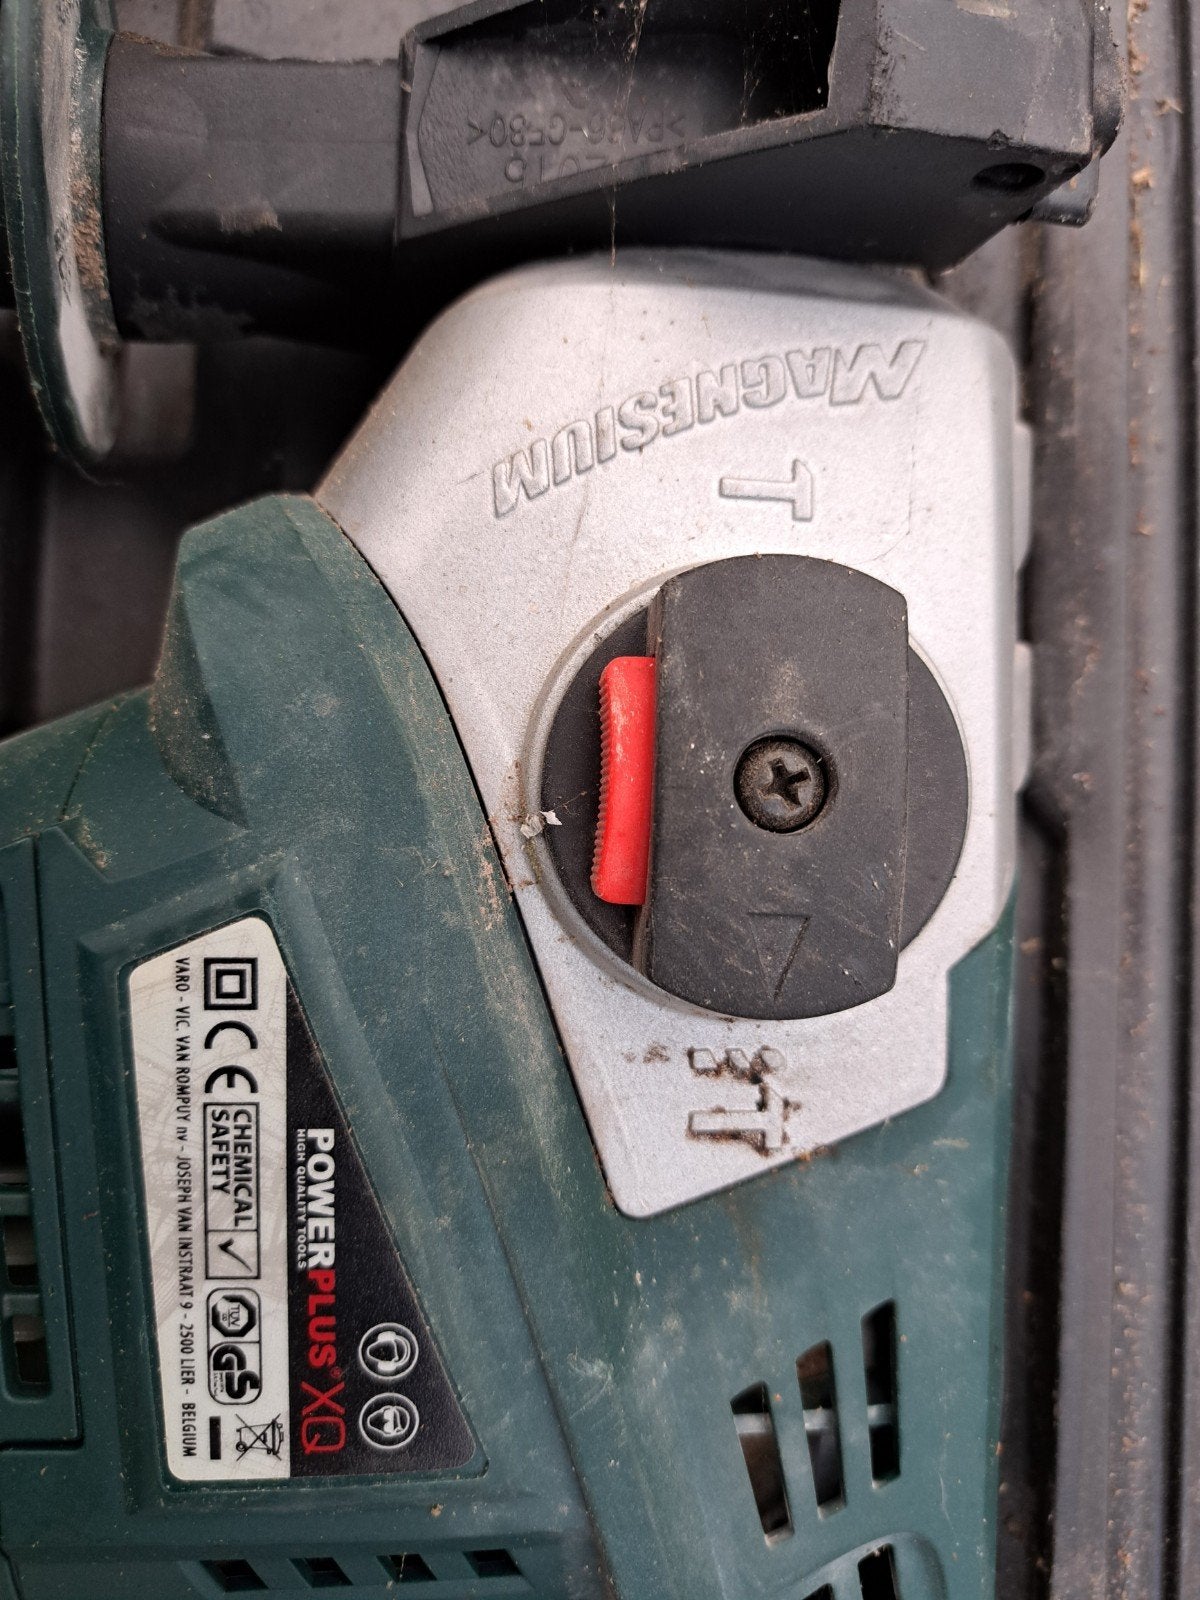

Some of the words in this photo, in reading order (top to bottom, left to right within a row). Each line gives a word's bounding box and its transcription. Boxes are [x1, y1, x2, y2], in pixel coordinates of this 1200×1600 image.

[492, 341, 926, 518] MAGNESIUM
[176, 957, 190, 991] VARO
[176, 1006, 190, 1030] VIC.
[176, 1036, 190, 1061] VAN
[176, 1067, 190, 1121] ROMPUY
[211, 1110, 230, 1194] SAFETY
[233, 1109, 252, 1227] CHEMICAL
[296, 1129, 306, 1162] HIGH
[177, 1156, 192, 1202] JOSEPH
[296, 1167, 306, 1226] QUALITY
[178, 1207, 192, 1232] VAN
[179, 1237, 193, 1297] INSTRAAT
[296, 1228, 307, 1270] TOOLS
[180, 1324, 194, 1354] 2500
[181, 1359, 195, 1384] LIER
[182, 1403, 196, 1456] BELGIUM
[300, 1381, 346, 1455] XQ
